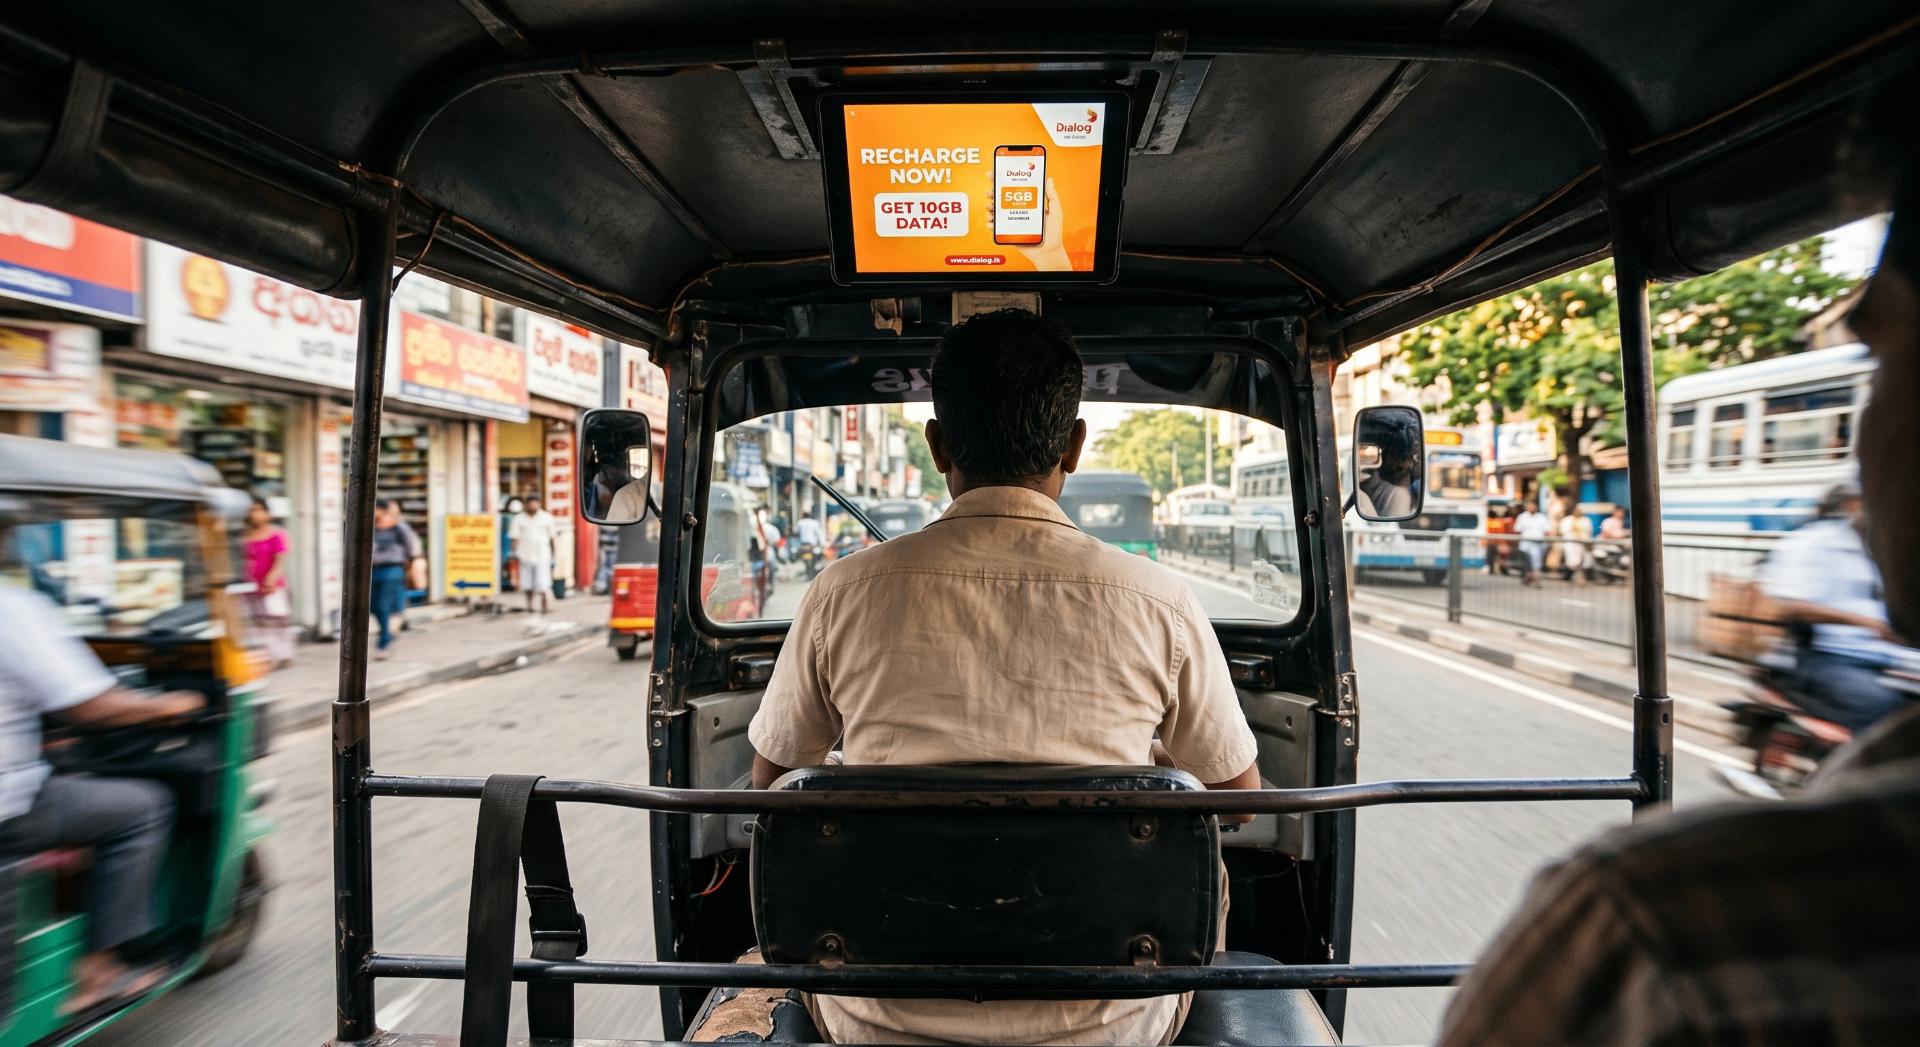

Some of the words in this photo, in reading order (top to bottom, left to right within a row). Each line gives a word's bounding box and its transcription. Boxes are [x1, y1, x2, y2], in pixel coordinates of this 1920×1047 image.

[1056, 122, 1092, 134] Dialog
[860, 147, 981, 164] RECHARGE
[890, 168, 952, 184] NOW!
[1006, 170, 1032, 178] Dialog
[1004, 192, 1033, 202] 5GB
[881, 202, 915, 214] GET
[919, 201, 963, 214] 10GB
[896, 217, 948, 230] DATA!
